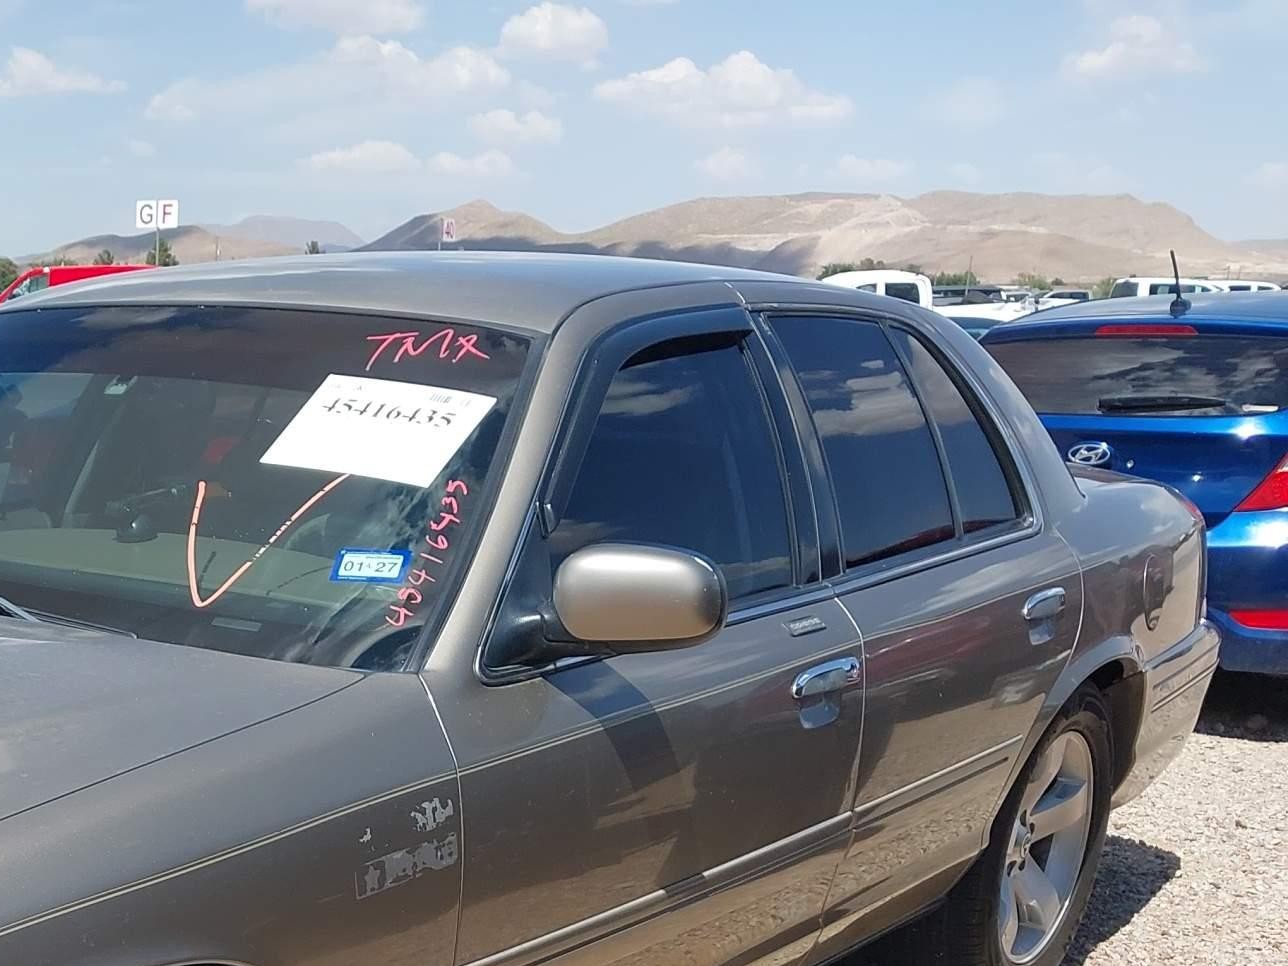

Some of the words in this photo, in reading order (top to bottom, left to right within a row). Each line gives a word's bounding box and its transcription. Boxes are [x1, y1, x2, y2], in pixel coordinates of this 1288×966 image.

[139, 203, 154, 225] G
[162, 203, 174, 225] F
[321, 397, 457, 428] 45416435
[385, 479, 468, 626] 45416435
[343, 560, 364, 572] 01
[374, 561, 399, 573] 27
